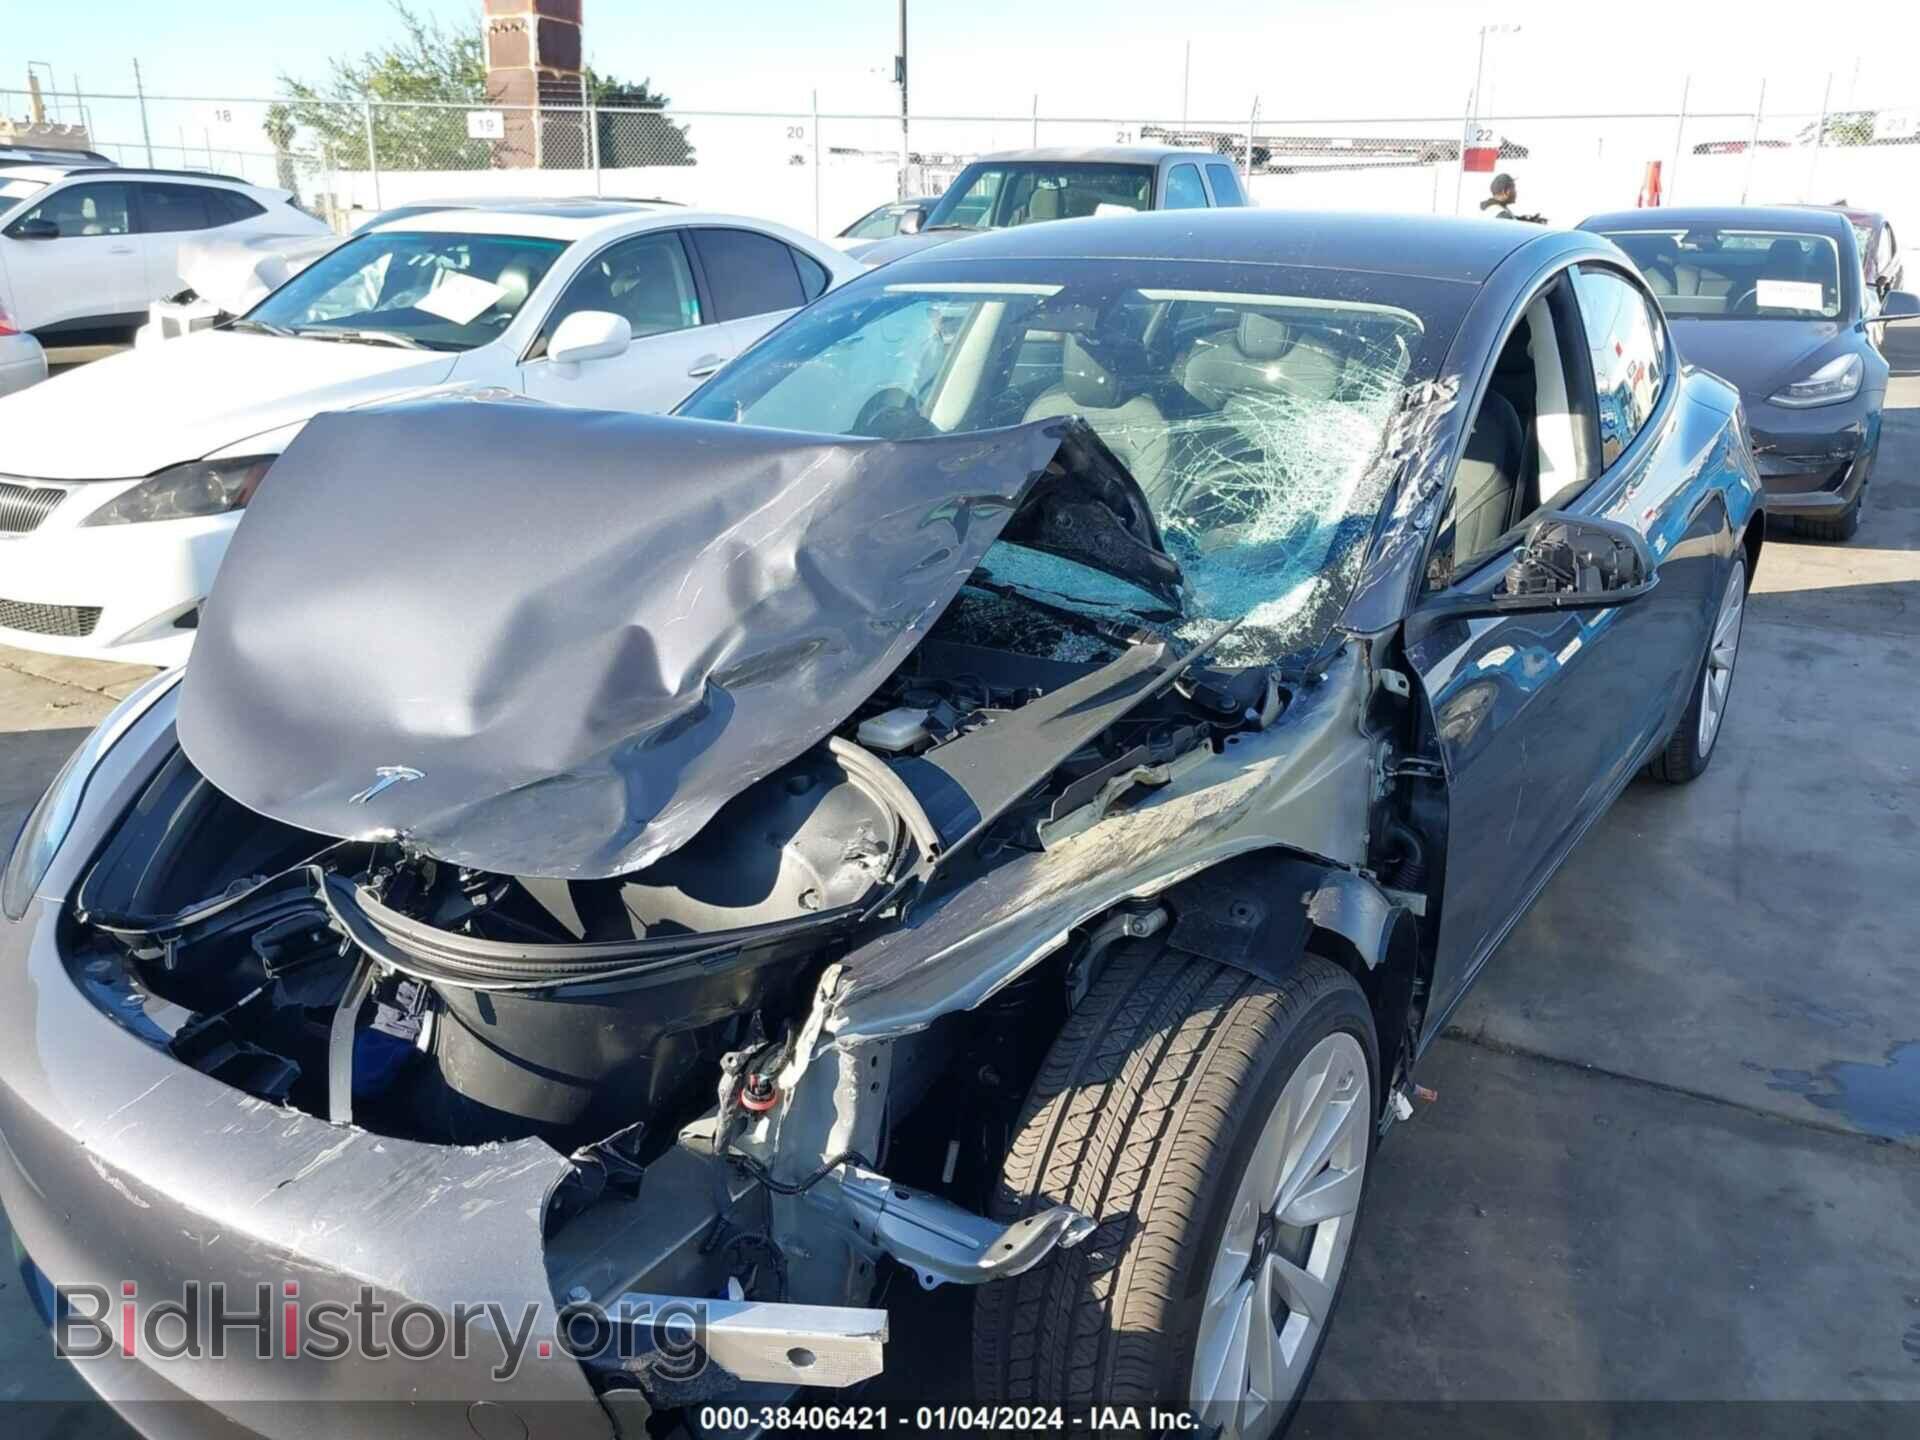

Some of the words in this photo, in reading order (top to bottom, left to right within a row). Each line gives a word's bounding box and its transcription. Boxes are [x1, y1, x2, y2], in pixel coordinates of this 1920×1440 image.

[215, 109, 232, 122] 18
[477, 119, 495, 131] 19
[786, 125, 804, 139] 20
[1115, 131, 1132, 144] 21
[1476, 129, 1494, 142] 22
